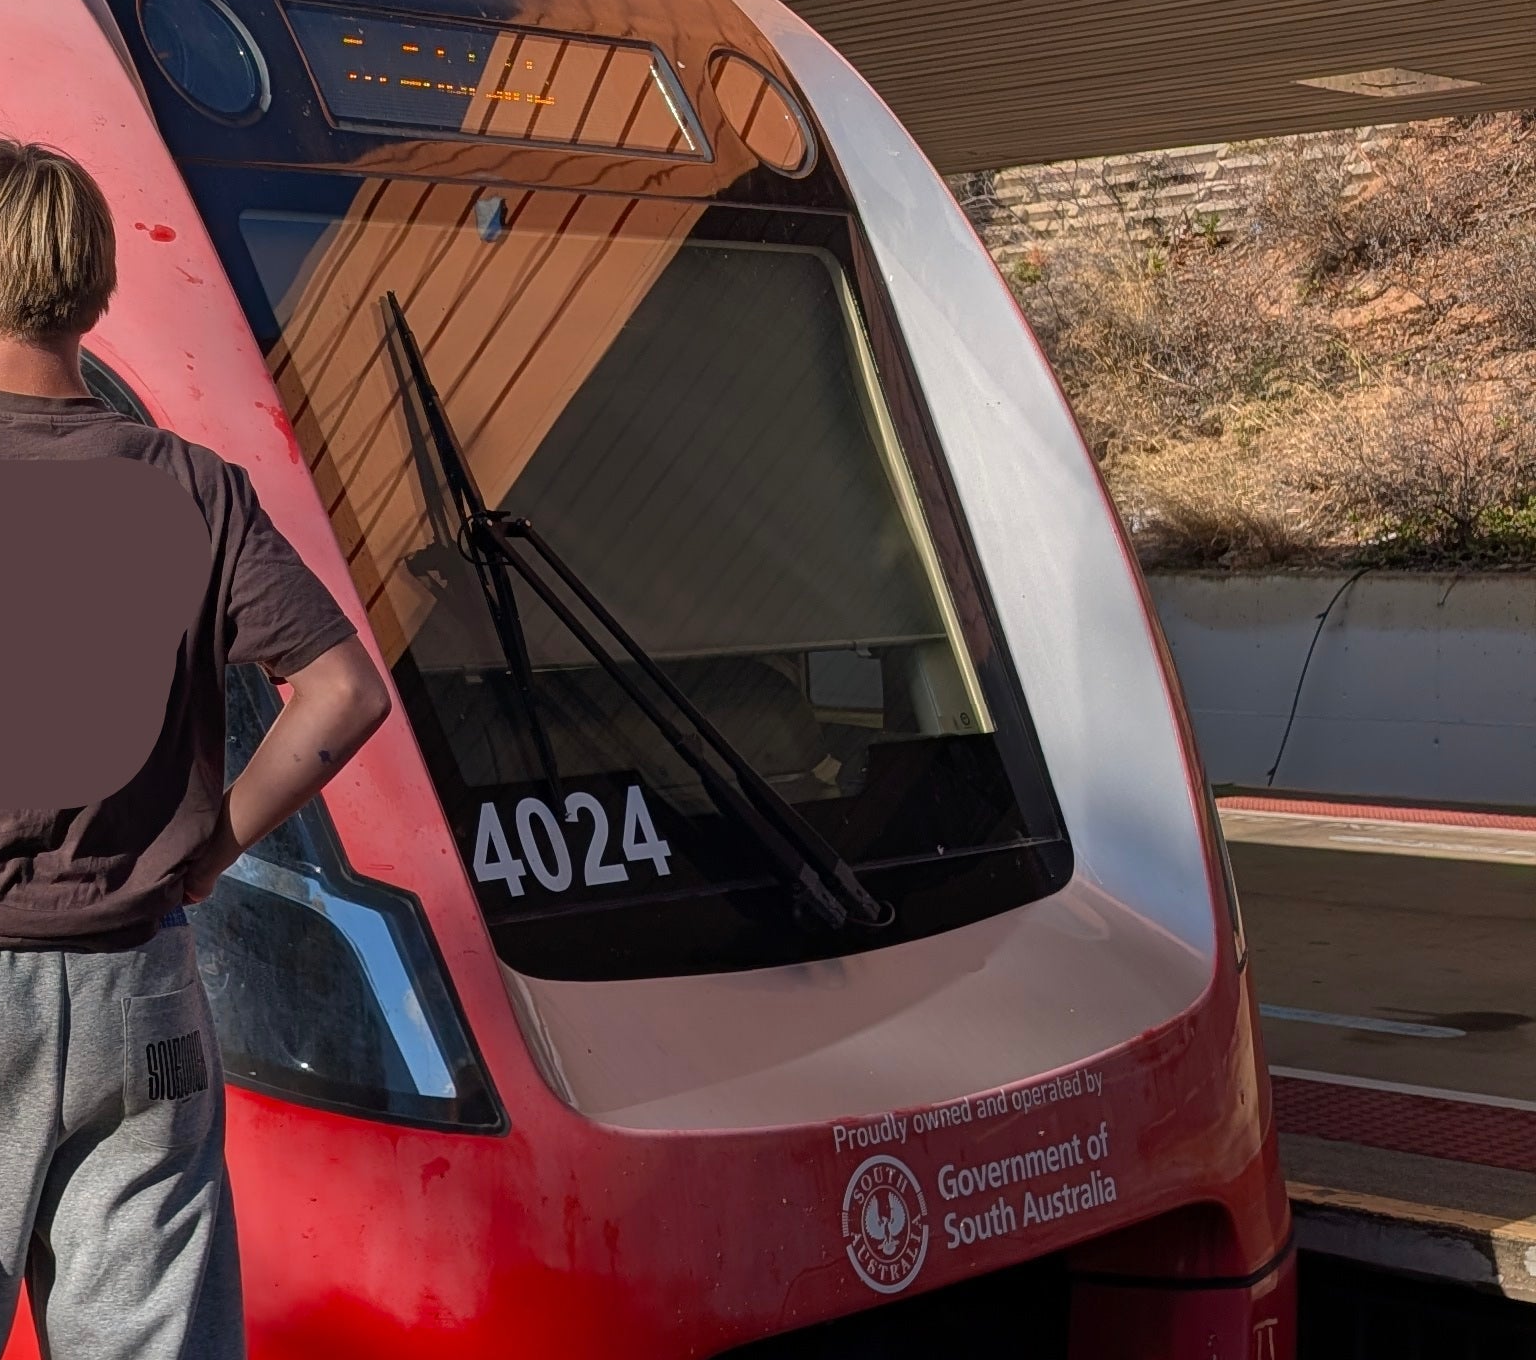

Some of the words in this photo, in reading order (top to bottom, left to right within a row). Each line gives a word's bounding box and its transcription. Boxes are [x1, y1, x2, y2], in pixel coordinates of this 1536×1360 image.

[472, 784, 672, 898] 4024
[832, 1112, 908, 1153] Proudly
[913, 1096, 973, 1134] owned
[977, 1089, 1008, 1120] and
[1011, 1070, 1082, 1115] operated
[1084, 1068, 1104, 1097] by
[853, 1165, 909, 1204] SOUTH
[938, 1131, 1082, 1201] Government
[1086, 1121, 1109, 1161] of
[850, 1214, 923, 1282] AUSTRALIA
[944, 1196, 1017, 1250] South
[1023, 1170, 1117, 1228] Australia
